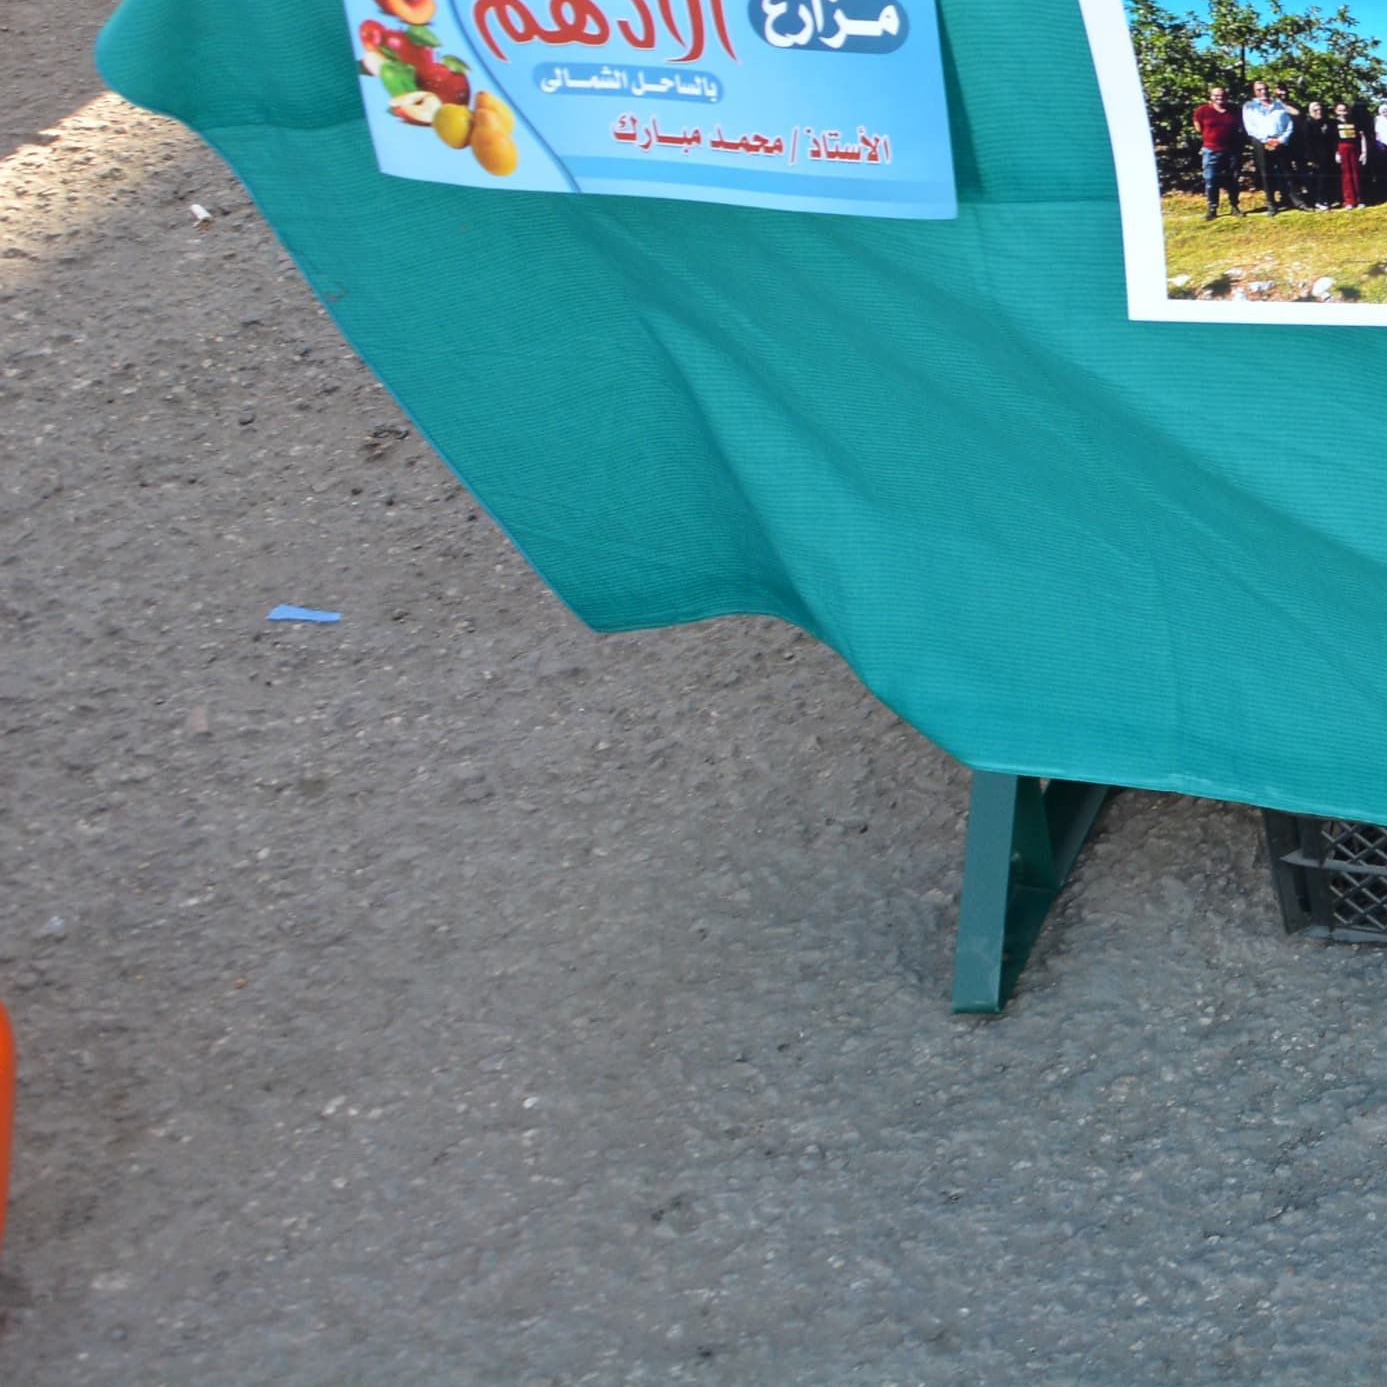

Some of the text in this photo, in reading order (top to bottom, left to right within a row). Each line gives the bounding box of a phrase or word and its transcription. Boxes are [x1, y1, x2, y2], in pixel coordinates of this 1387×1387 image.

[612, 113, 702, 153] مبارك
[709, 124, 784, 157] محمد
[806, 126, 891, 164] الأستاذ
